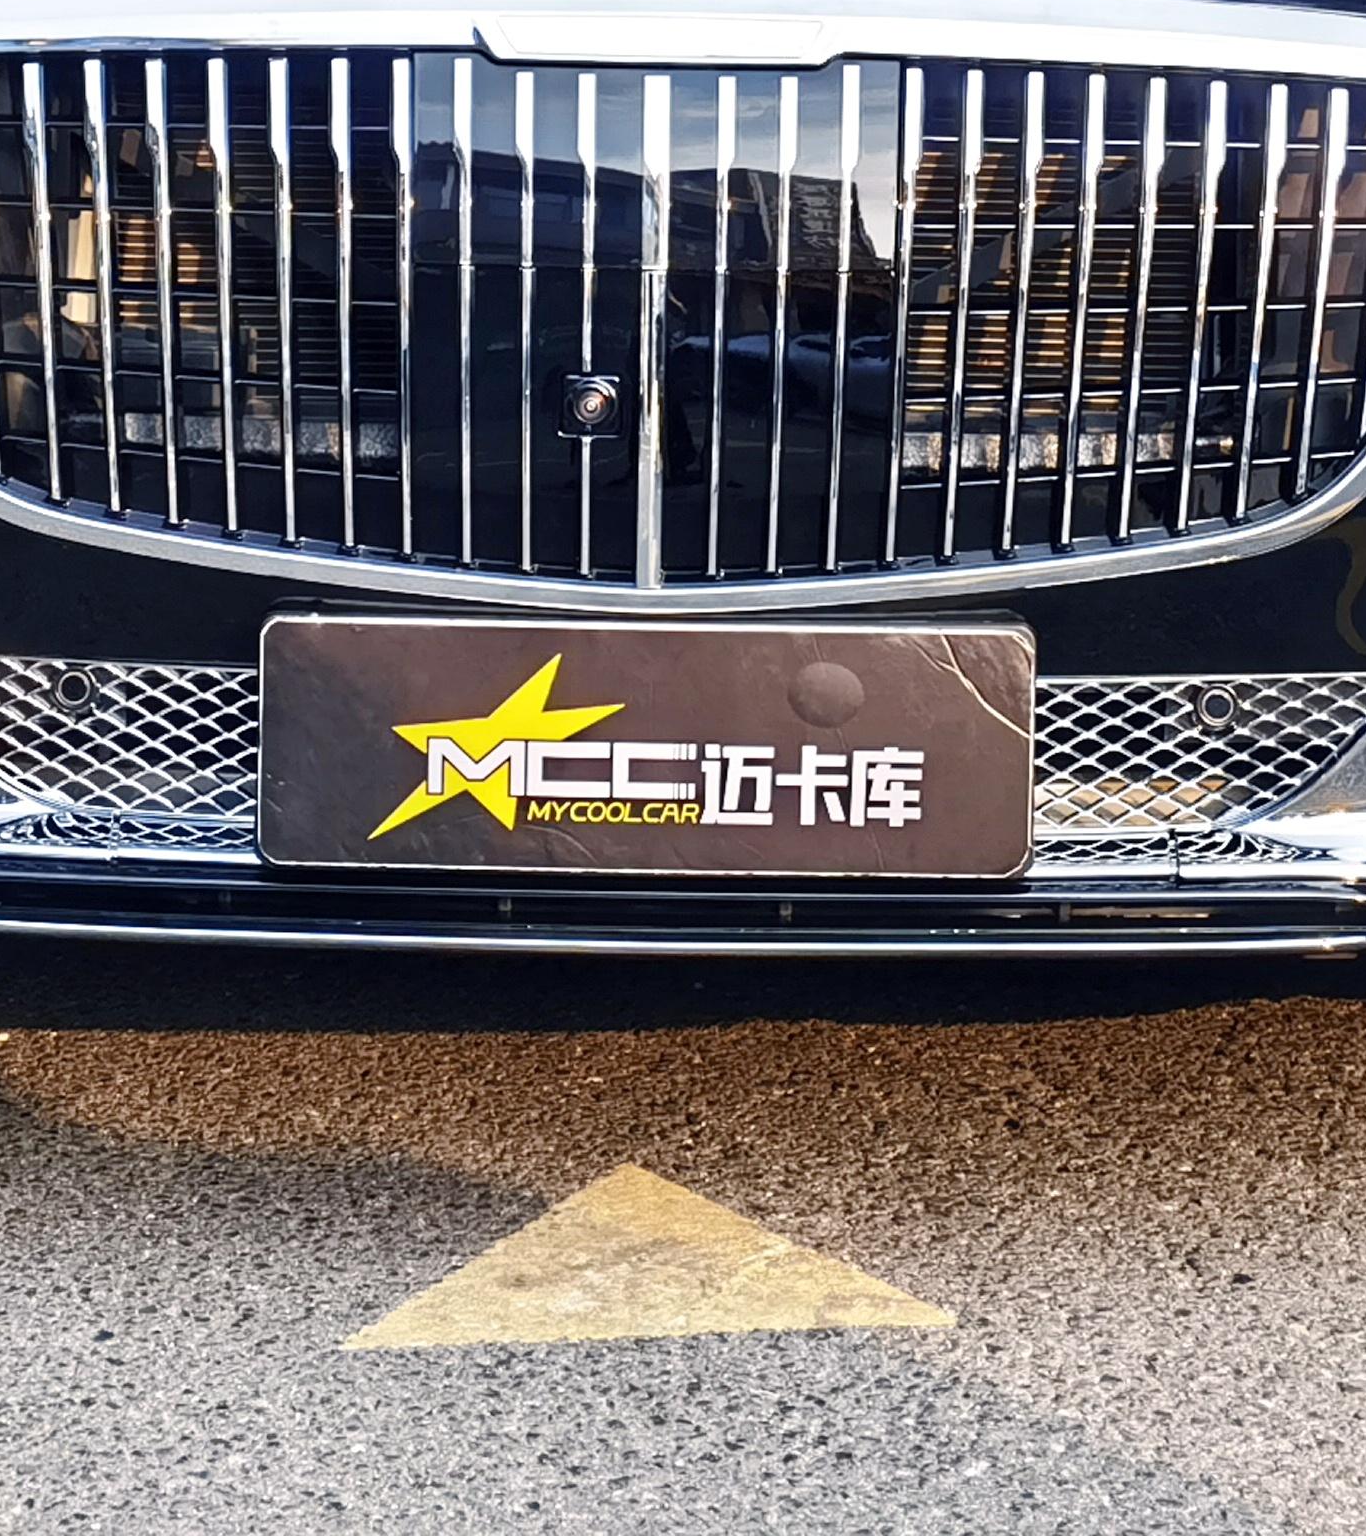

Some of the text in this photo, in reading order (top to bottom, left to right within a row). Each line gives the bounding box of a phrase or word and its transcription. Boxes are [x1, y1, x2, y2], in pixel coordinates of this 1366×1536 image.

[426, 737, 697, 799] MCC
[700, 743, 925, 827] 迈卡库
[527, 799, 700, 826] MYCOOLCAR
